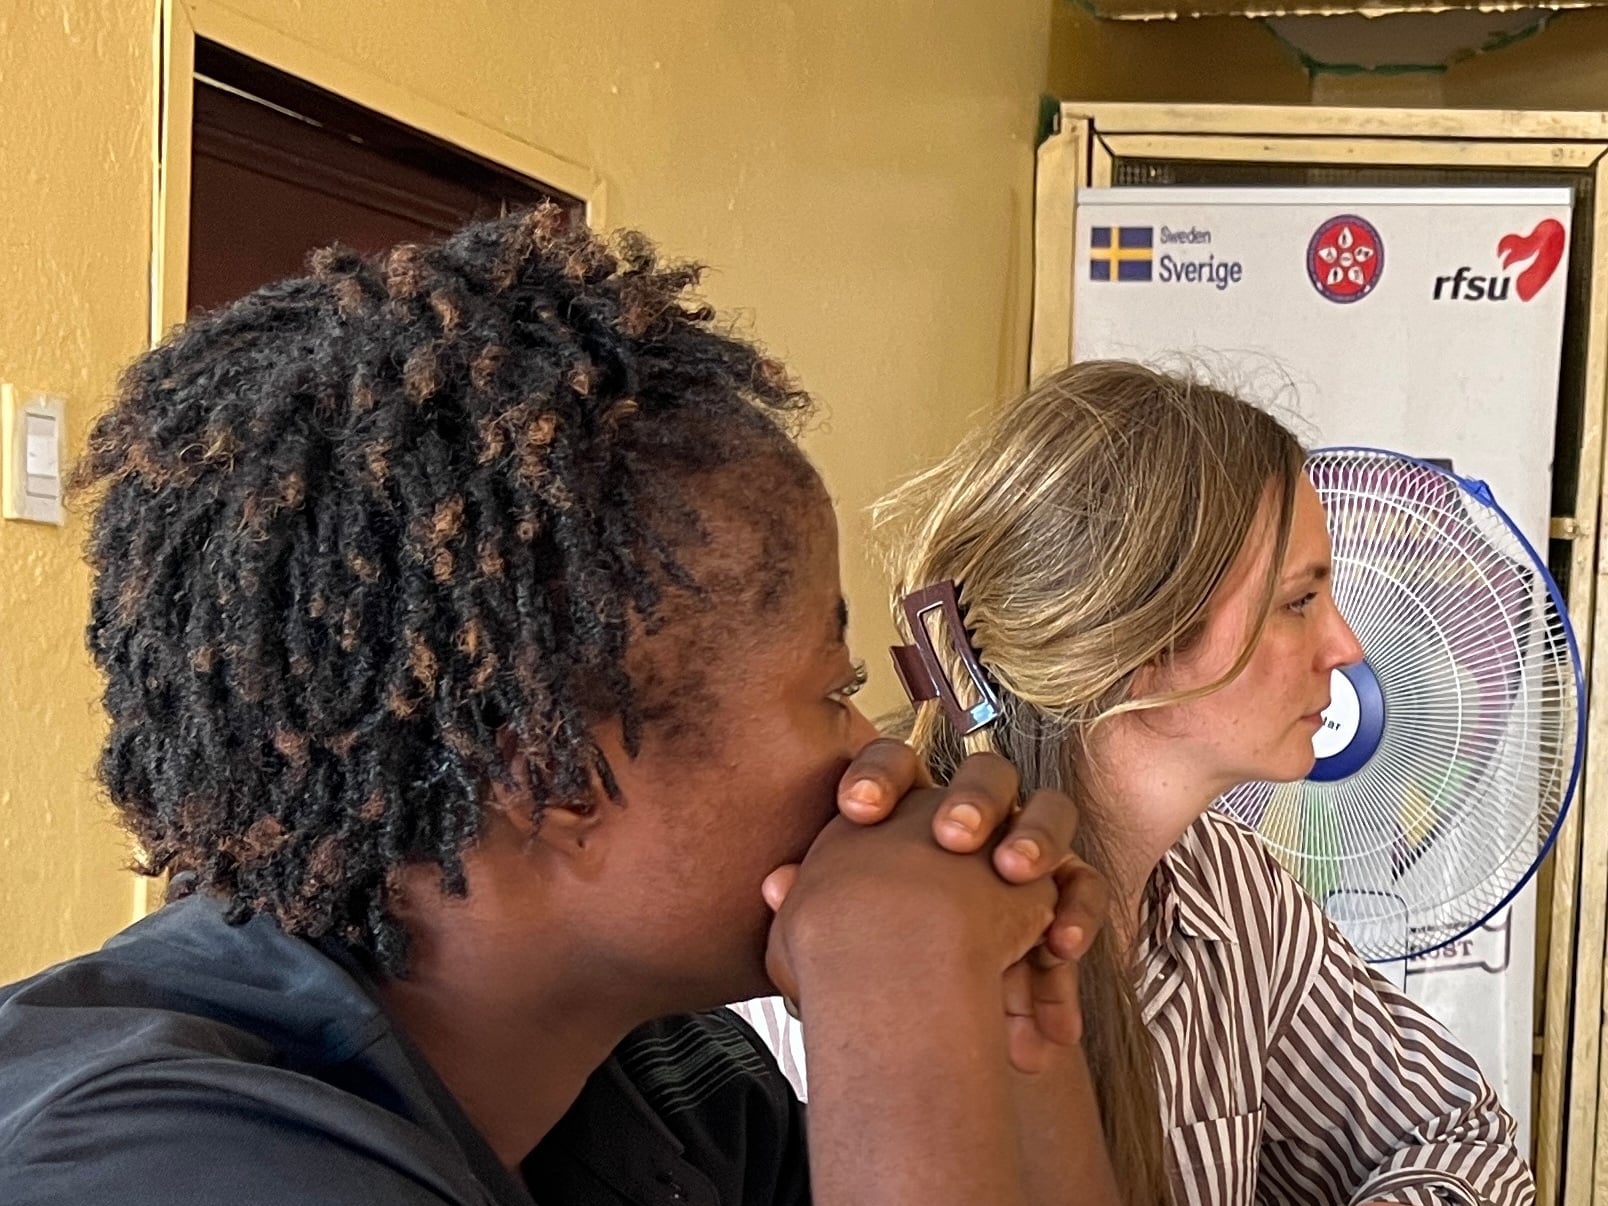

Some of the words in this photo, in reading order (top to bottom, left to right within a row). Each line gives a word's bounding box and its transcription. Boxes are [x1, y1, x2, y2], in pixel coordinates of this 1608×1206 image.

[1160, 225, 1211, 244] Sweden
[1159, 253, 1242, 290] Sverige
[1433, 266, 1511, 301] rfsu
